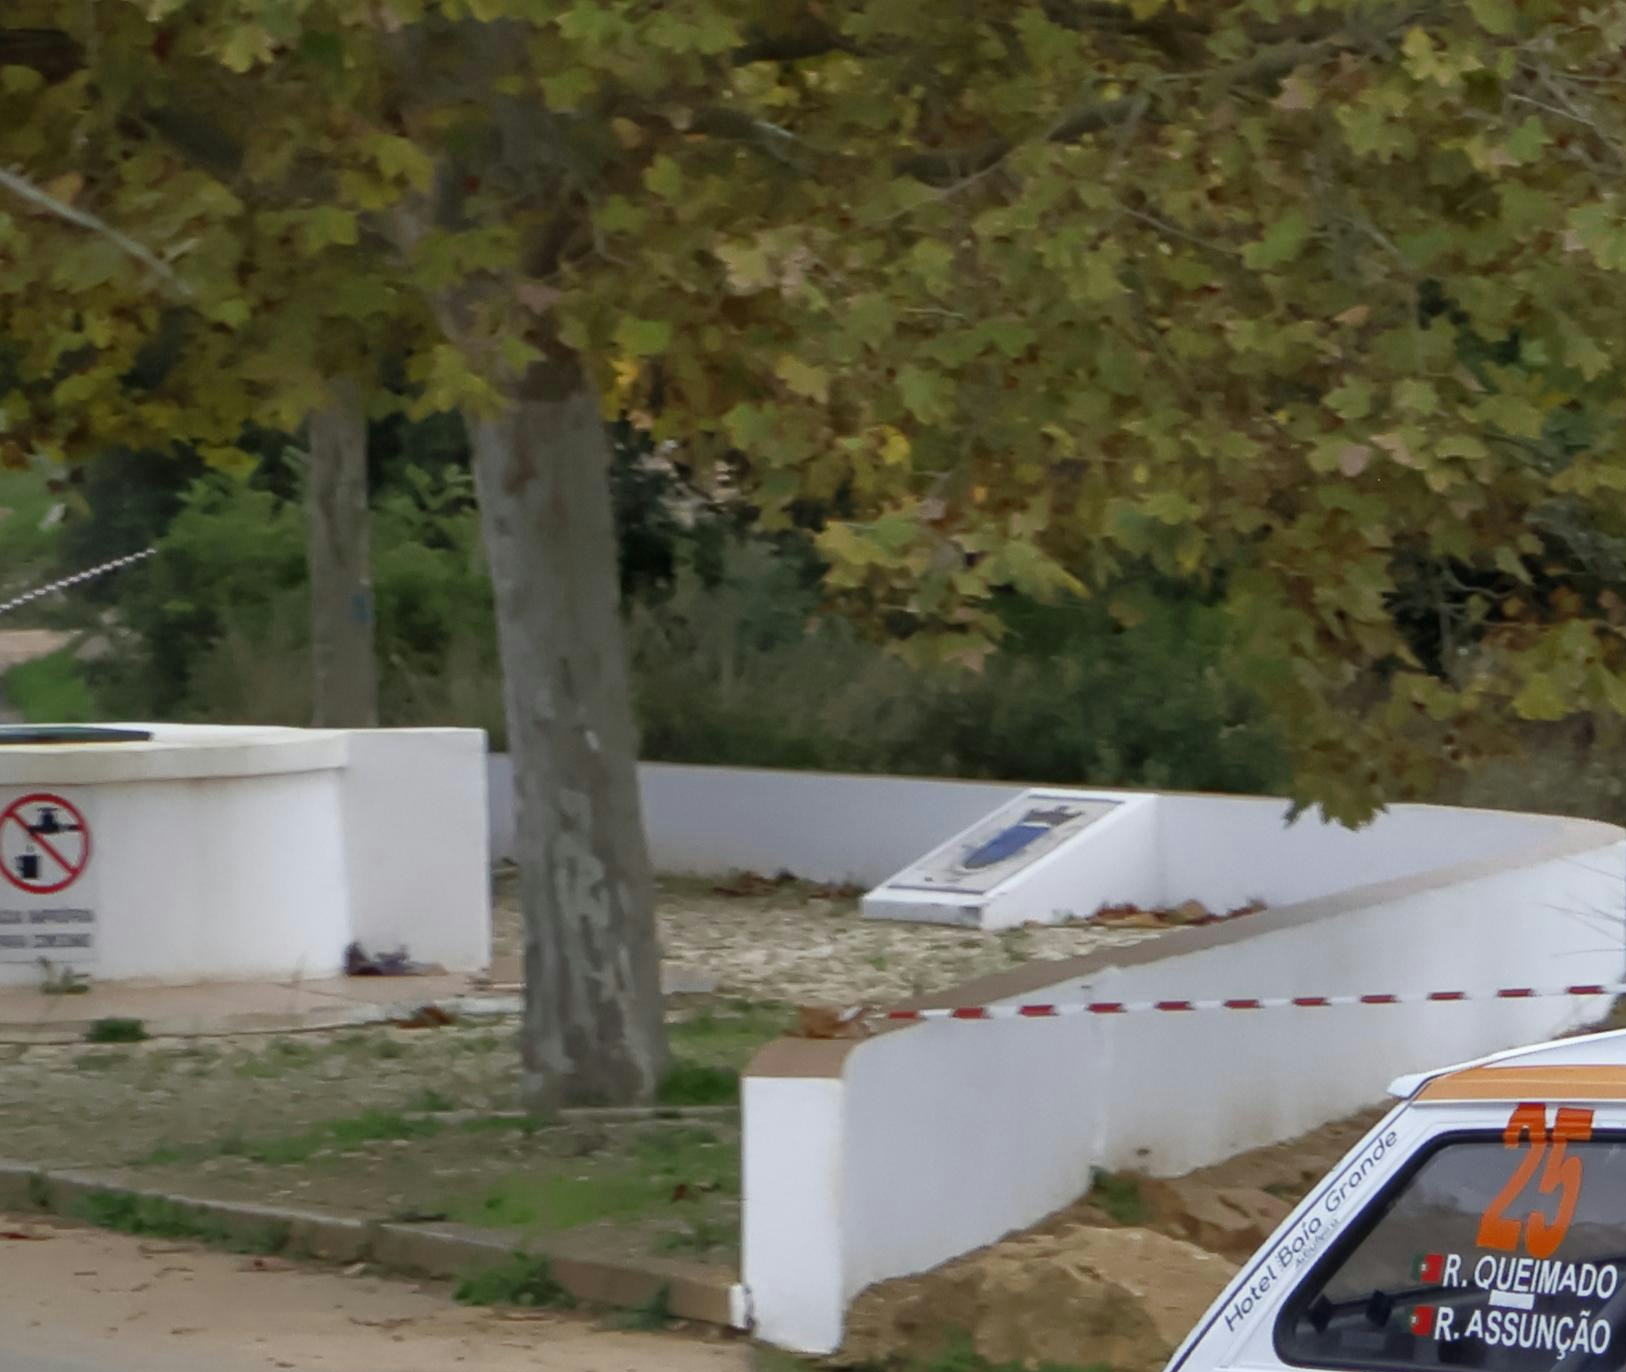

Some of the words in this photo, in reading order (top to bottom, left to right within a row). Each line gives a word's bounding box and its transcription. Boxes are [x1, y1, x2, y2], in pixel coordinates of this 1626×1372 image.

[1224, 1265, 1278, 1332] Hotel
[1324, 1130, 1399, 1213] Grande
[1475, 1102, 1595, 1260] 25
[1442, 1254, 1468, 1288] R.
[1474, 1255, 1618, 1300] QUEIMADO
[1434, 1306, 1460, 1341] R.
[1464, 1310, 1612, 1361] ASSUNÇÃO
